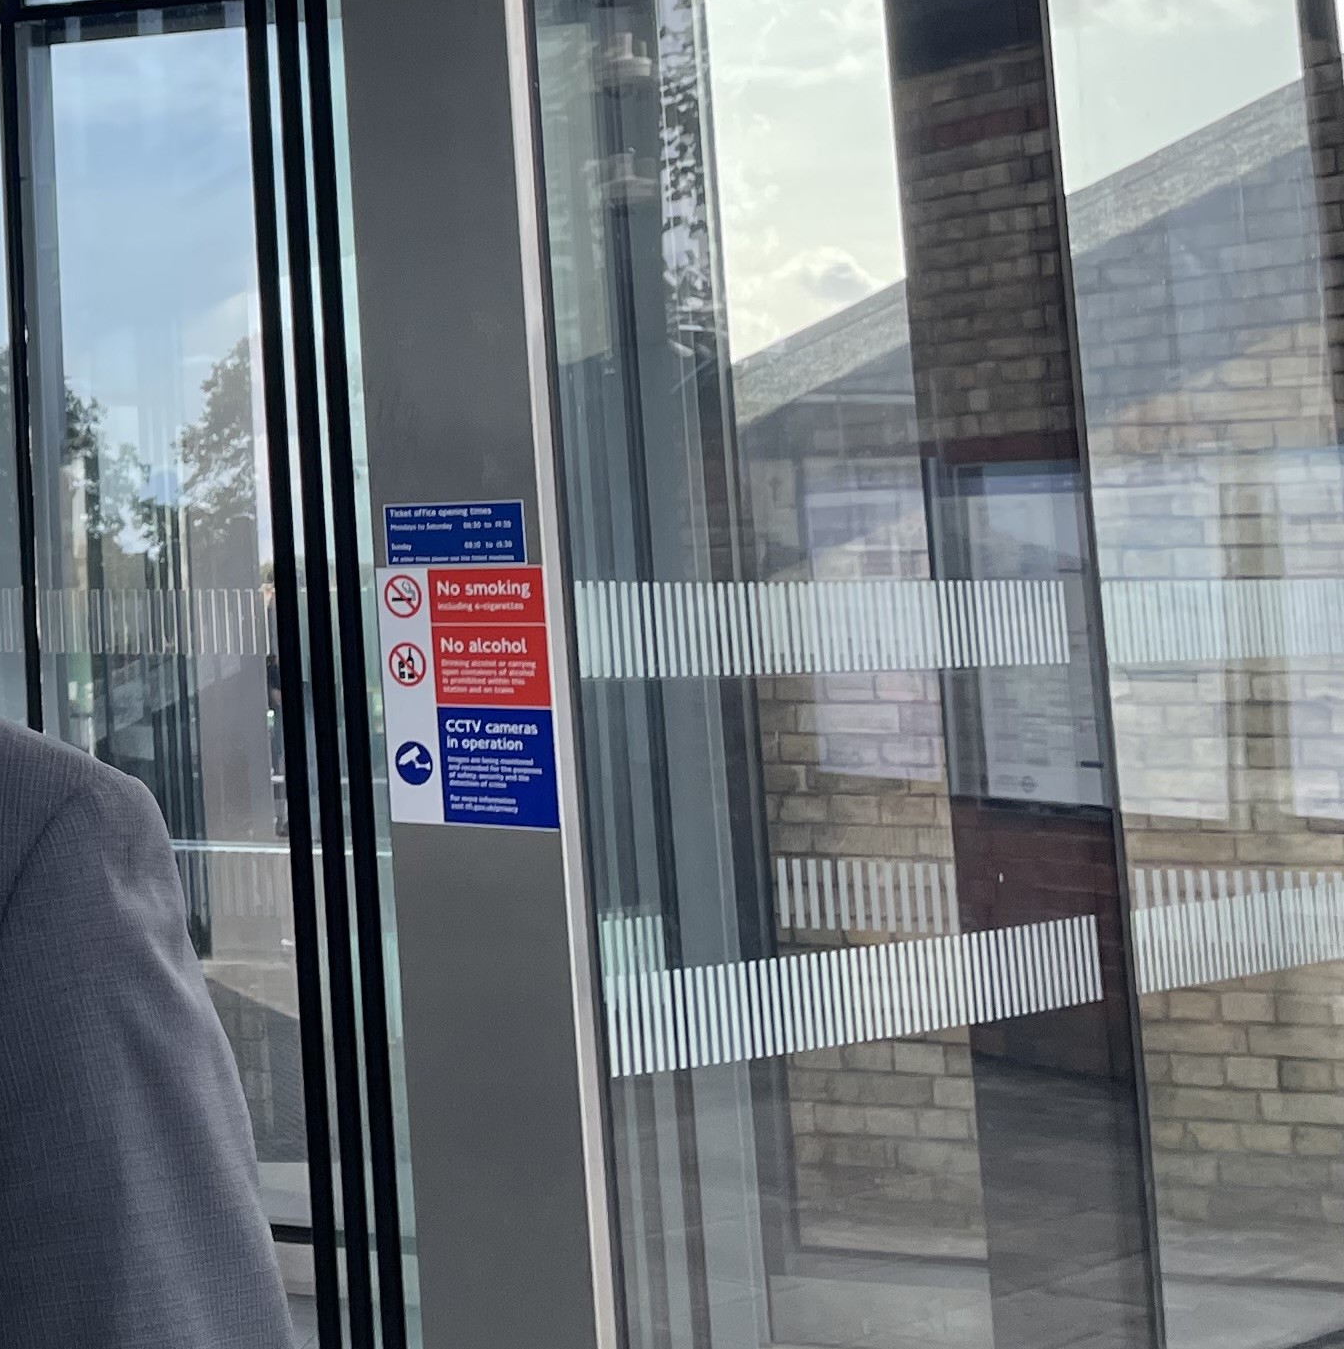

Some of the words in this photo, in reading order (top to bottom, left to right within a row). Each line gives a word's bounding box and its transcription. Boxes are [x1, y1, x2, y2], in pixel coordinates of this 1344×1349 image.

[390, 508, 412, 518] Ticket
[413, 508, 436, 518] office
[438, 508, 468, 518] opening
[437, 579, 460, 597] No
[464, 579, 531, 600] smoking
[440, 636, 464, 653] No
[468, 637, 528, 654] alcohol
[445, 719, 481, 733] CCTV
[485, 723, 539, 735] cameras
[446, 735, 459, 749] in
[461, 737, 524, 752] operation
